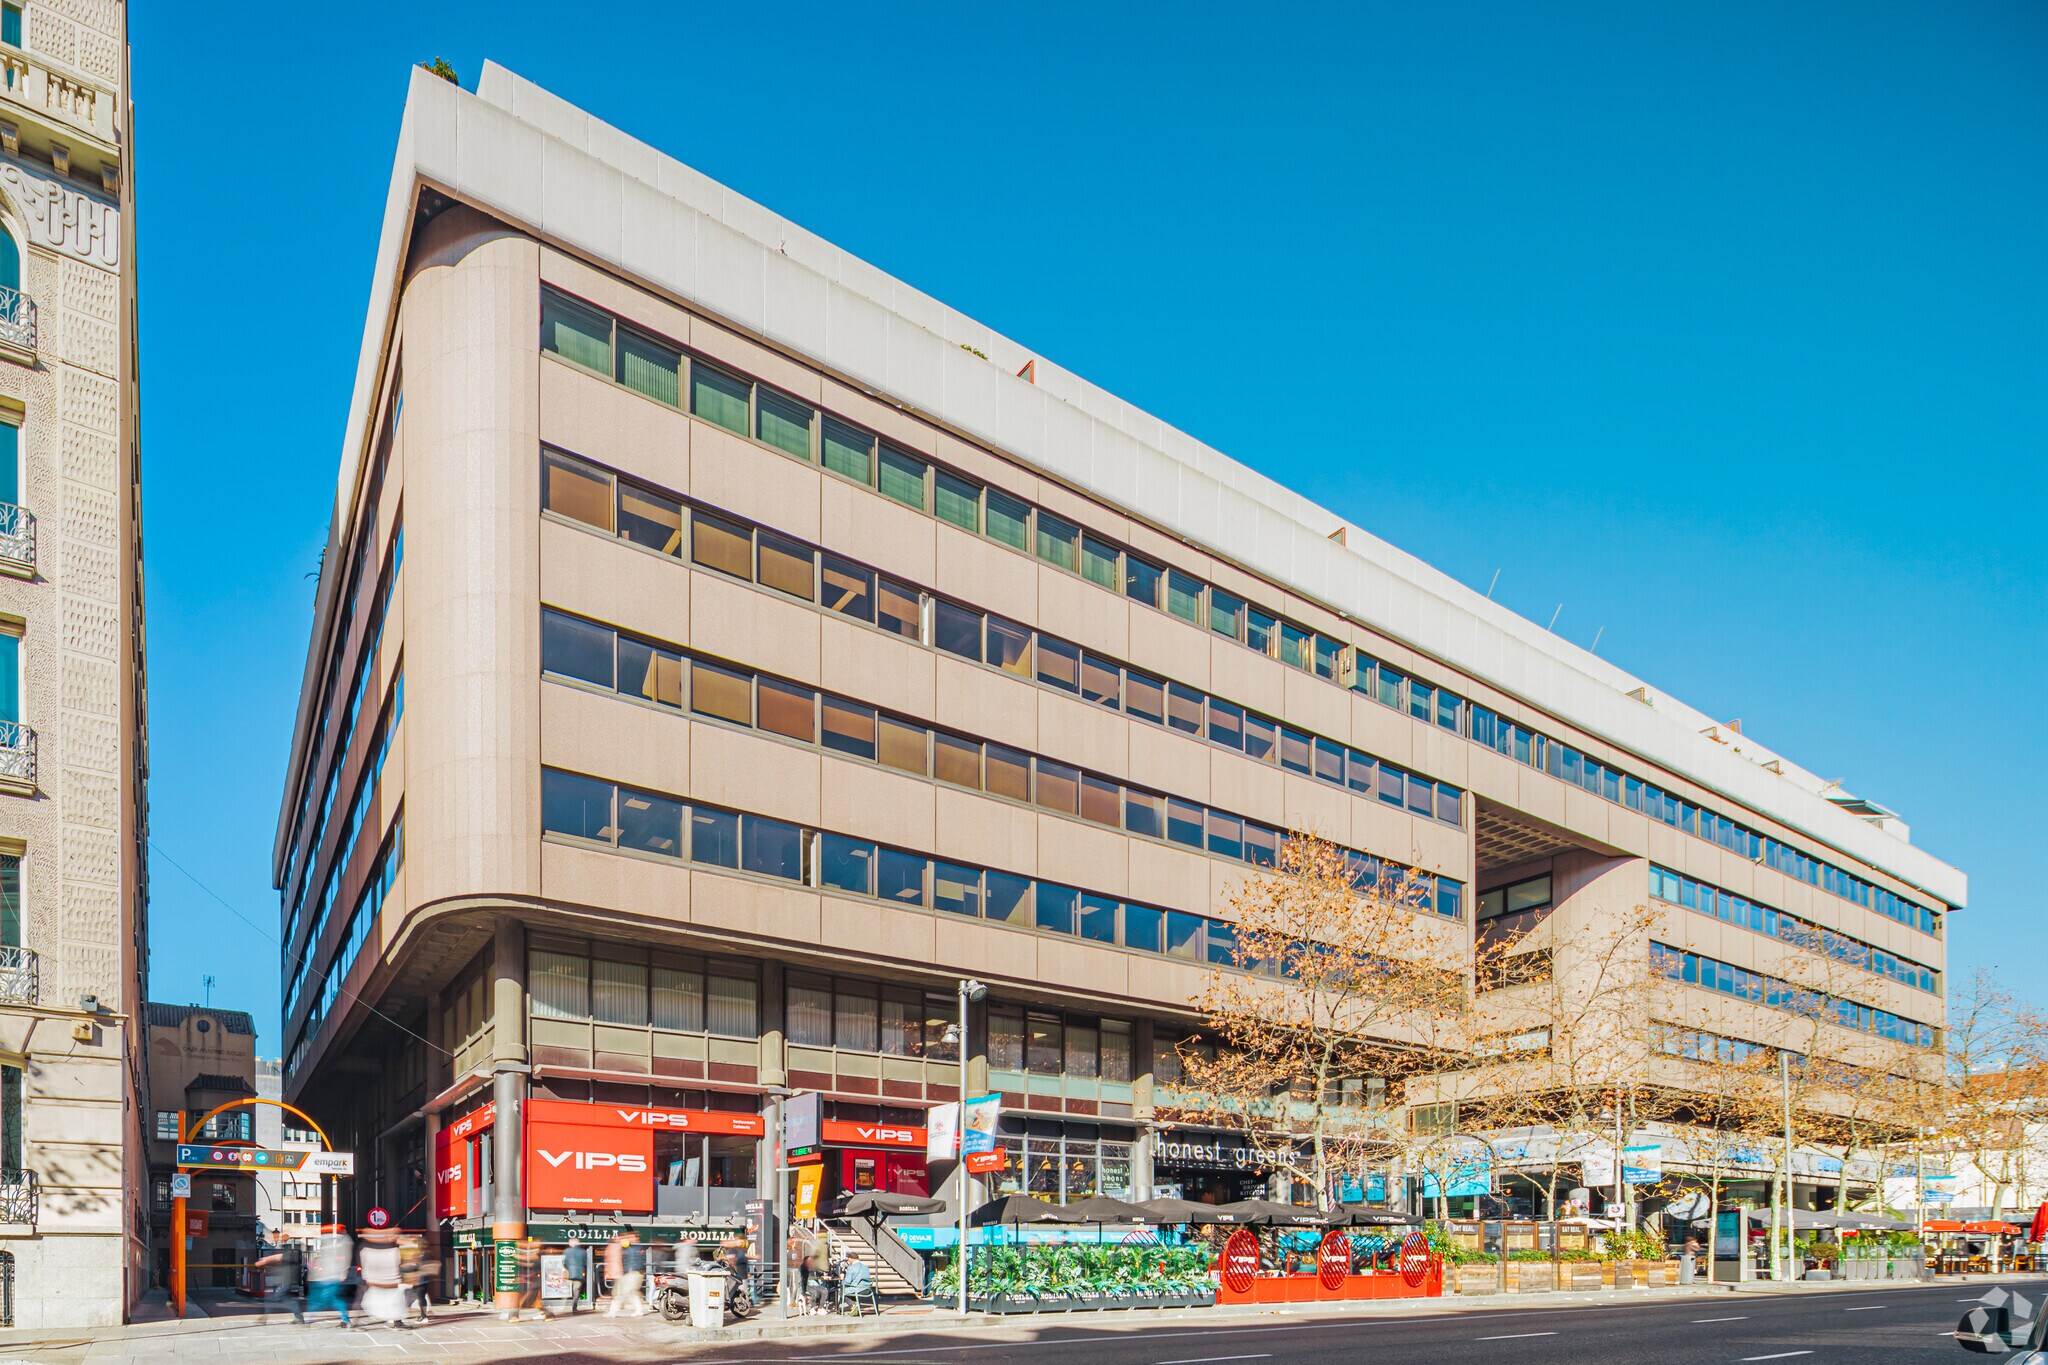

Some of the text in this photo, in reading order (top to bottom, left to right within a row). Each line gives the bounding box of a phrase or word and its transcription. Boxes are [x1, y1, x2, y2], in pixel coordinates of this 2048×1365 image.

[617, 1110, 688, 1127] VIPS
[453, 1118, 473, 1137] VIPS
[856, 1127, 913, 1142] VIPS
[181, 1148, 191, 1160] P
[1157, 1132, 1297, 1169] honest greens
[314, 1159, 347, 1168] empark
[536, 1149, 647, 1172] VIPS
[971, 1154, 998, 1164] VIPS
[437, 1164, 462, 1185] VIPS
[893, 1169, 925, 1177] VIPS
[1102, 1164, 1123, 1174] honest
[1102, 1173, 1123, 1182] beans
[558, 1229, 619, 1239] RODILLA
[680, 1230, 735, 1241] RODILLA
[1230, 1255, 1256, 1263] VIPS
